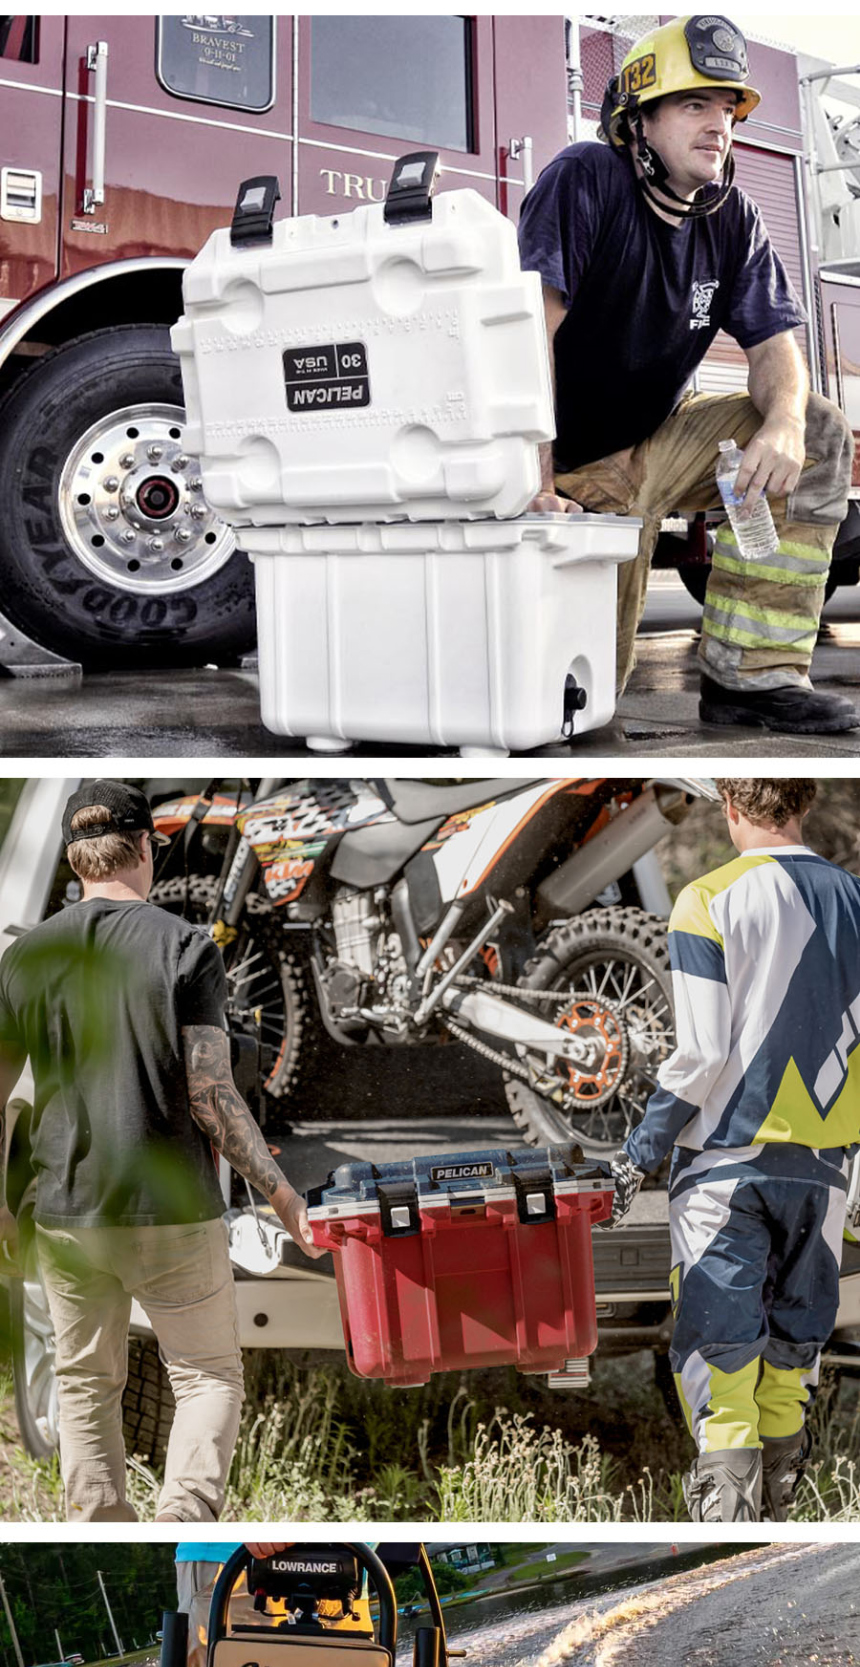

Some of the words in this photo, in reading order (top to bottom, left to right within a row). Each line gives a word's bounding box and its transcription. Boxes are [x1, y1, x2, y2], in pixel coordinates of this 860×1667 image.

[192, 33, 245, 53] BRAVEST
[320, 169, 389, 202] TRU
[293, 356, 327, 369] USA
[341, 354, 361, 368] 30
[293, 384, 363, 405] PELICAN
[21, 446, 198, 627] GOODYEAR
[437, 1166, 487, 1179] PELICAN
[272, 1560, 337, 1573] LOWRANCE
